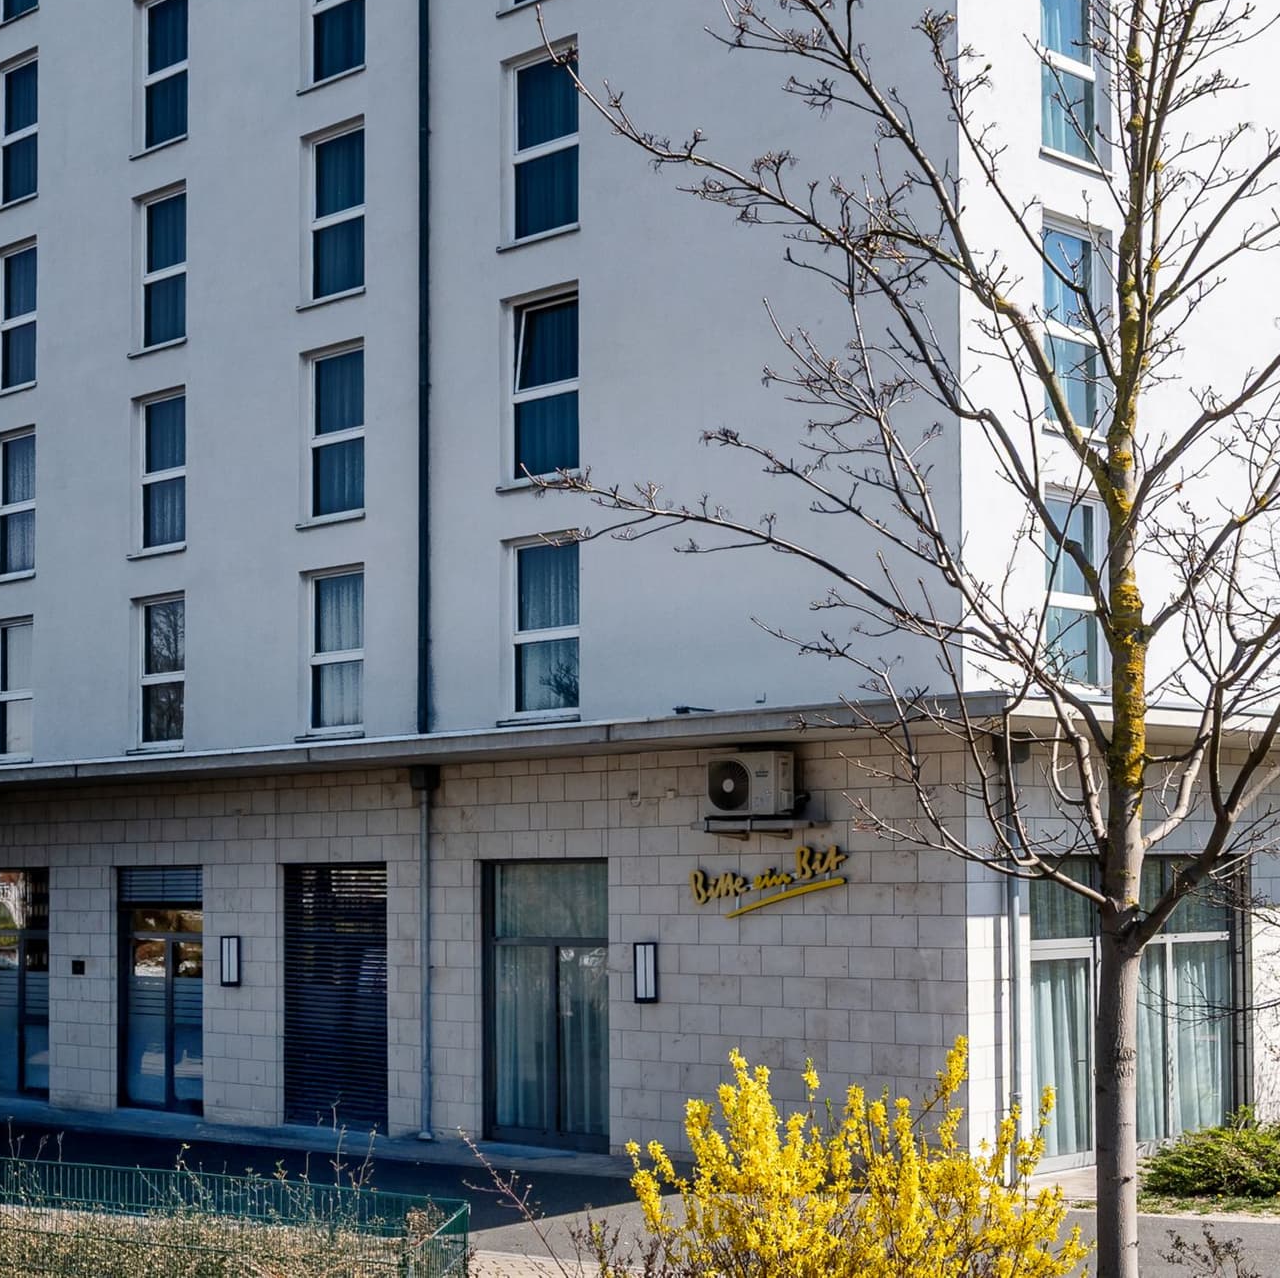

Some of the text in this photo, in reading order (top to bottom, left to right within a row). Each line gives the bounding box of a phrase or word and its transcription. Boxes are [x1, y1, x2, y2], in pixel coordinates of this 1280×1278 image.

[689, 844, 848, 905] Bitte ein Bit
